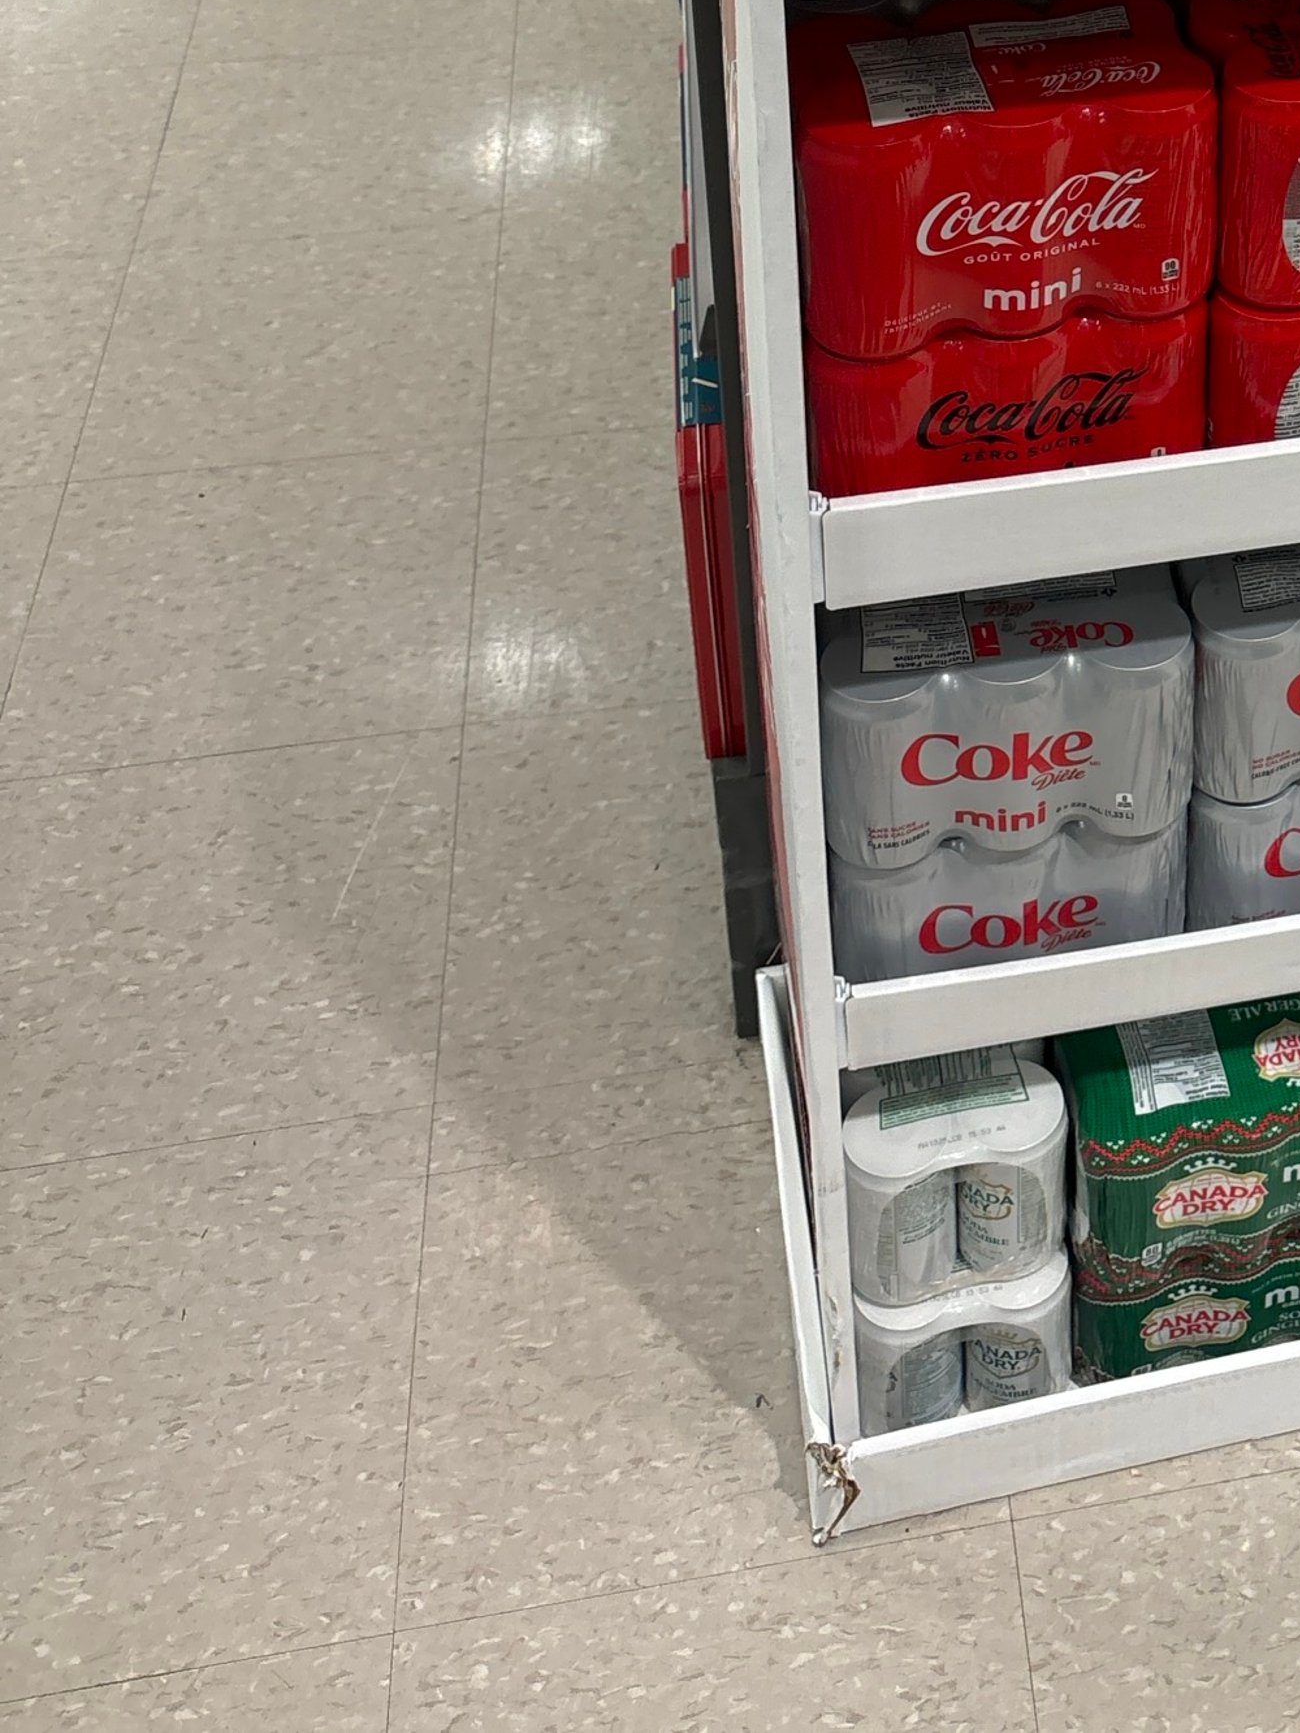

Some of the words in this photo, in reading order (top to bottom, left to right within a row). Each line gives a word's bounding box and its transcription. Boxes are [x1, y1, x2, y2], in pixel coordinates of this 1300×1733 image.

[1039, 61, 1161, 98] Coca-Cola
[964, 251, 1013, 265] GOÛT
[1019, 238, 1101, 262] ORIGINAL
[983, 266, 1083, 312] mini
[1112, 283, 1132, 294] 222
[1131, 284, 1147, 295] mL
[915, 367, 1151, 452] Coca-Cola
[961, 447, 1019, 463] ZÉRO
[1027, 434, 1096, 458] SUCRE
[1029, 620, 1134, 648] Coke
[900, 730, 1094, 787] Coke
[1031, 767, 1088, 792] Diète
[955, 800, 1047, 833] mini
[918, 893, 1099, 955] Coke
[1041, 927, 1093, 953] Diète
[1227, 1003, 1265, 1022] ALE
[1152, 1183, 1268, 1215] CANADA
[1142, 1309, 1250, 1337] CANADA
